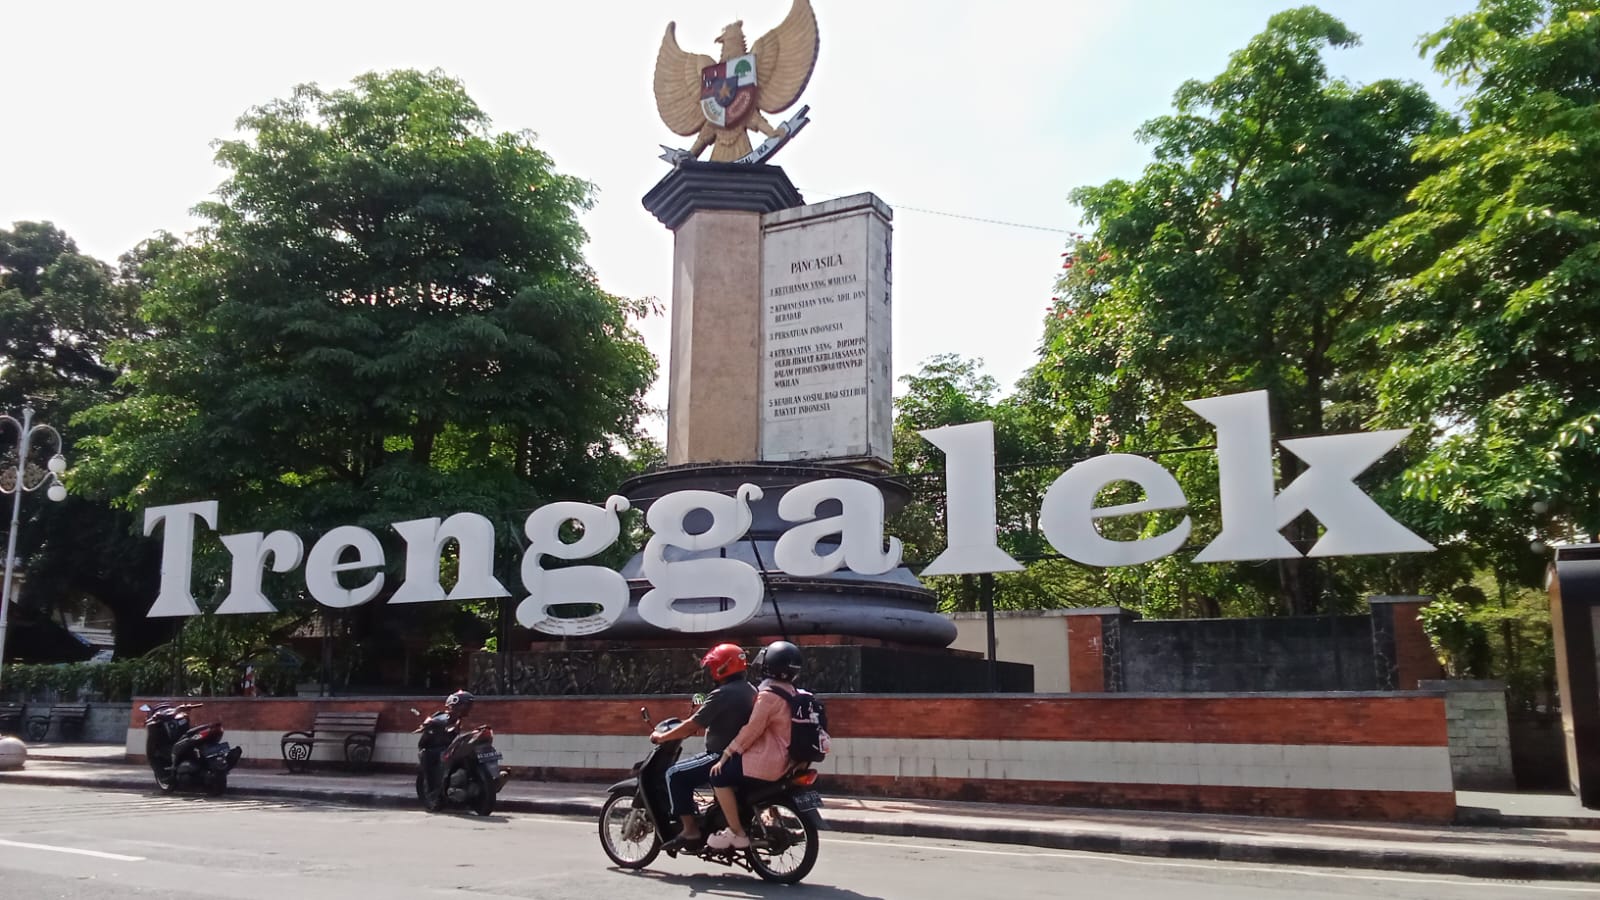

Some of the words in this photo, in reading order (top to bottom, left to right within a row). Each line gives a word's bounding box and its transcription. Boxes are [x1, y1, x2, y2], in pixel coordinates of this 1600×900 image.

[791, 254, 843, 274] PANCASILA
[775, 282, 809, 296] KETUHANAN
[810, 280, 826, 289] YANG
[775, 299, 816, 312] KEMANUSIAAN
[818, 297, 834, 305] YANG
[837, 293, 850, 302] ADIL
[853, 290, 866, 300] DAN
[775, 311, 802, 323] BERADAB
[775, 328, 808, 340] PERSATUAN
[810, 322, 843, 334] INDONESIA
[775, 345, 811, 357] KERAKYATAN
[816, 343, 832, 351] YANG
[837, 337, 866, 349] DIPIMPIN
[792, 355, 814, 365] HIKMAT
[775, 369, 793, 379] DALAM
[775, 378, 799, 388] WAKILAN
[774, 396, 802, 406] KEADILAN
[803, 392, 824, 402] SOSIAL
[825, 390, 838, 400] BAGI
[775, 406, 796, 417] RAKYAT
[799, 402, 830, 414] INDONESIA
[143, 389, 1437, 635] Trenggalek
